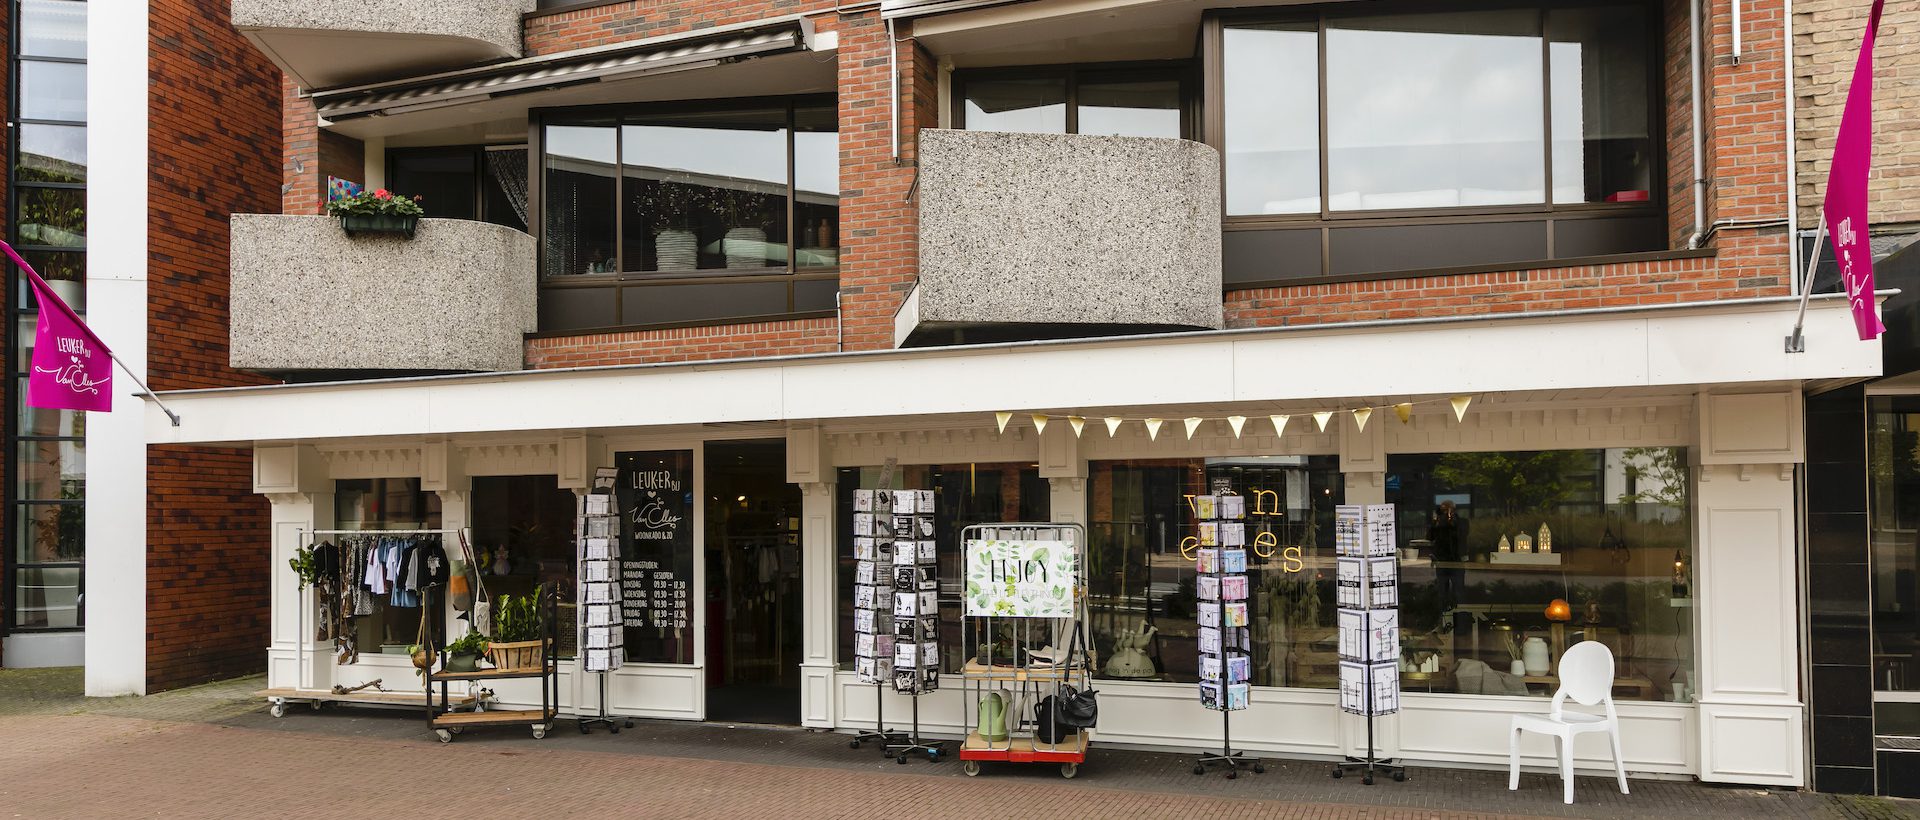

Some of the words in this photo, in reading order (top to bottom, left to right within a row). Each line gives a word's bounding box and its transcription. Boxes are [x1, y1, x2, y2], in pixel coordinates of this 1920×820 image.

[57, 336, 85, 355] LEUKER
[632, 471, 671, 490] LEUKER
[623, 570, 645, 578] MAANDAG
[653, 572, 674, 580] GESLOTEN
[991, 559, 1050, 583] ENJOY
[653, 580, 667, 589] 09.30
[623, 590, 647, 598] WOENSDAG
[653, 590, 667, 599] 09.30
[653, 600, 667, 608] 09.30
[653, 610, 667, 618] 09.30
[653, 619, 667, 628] 09.30
